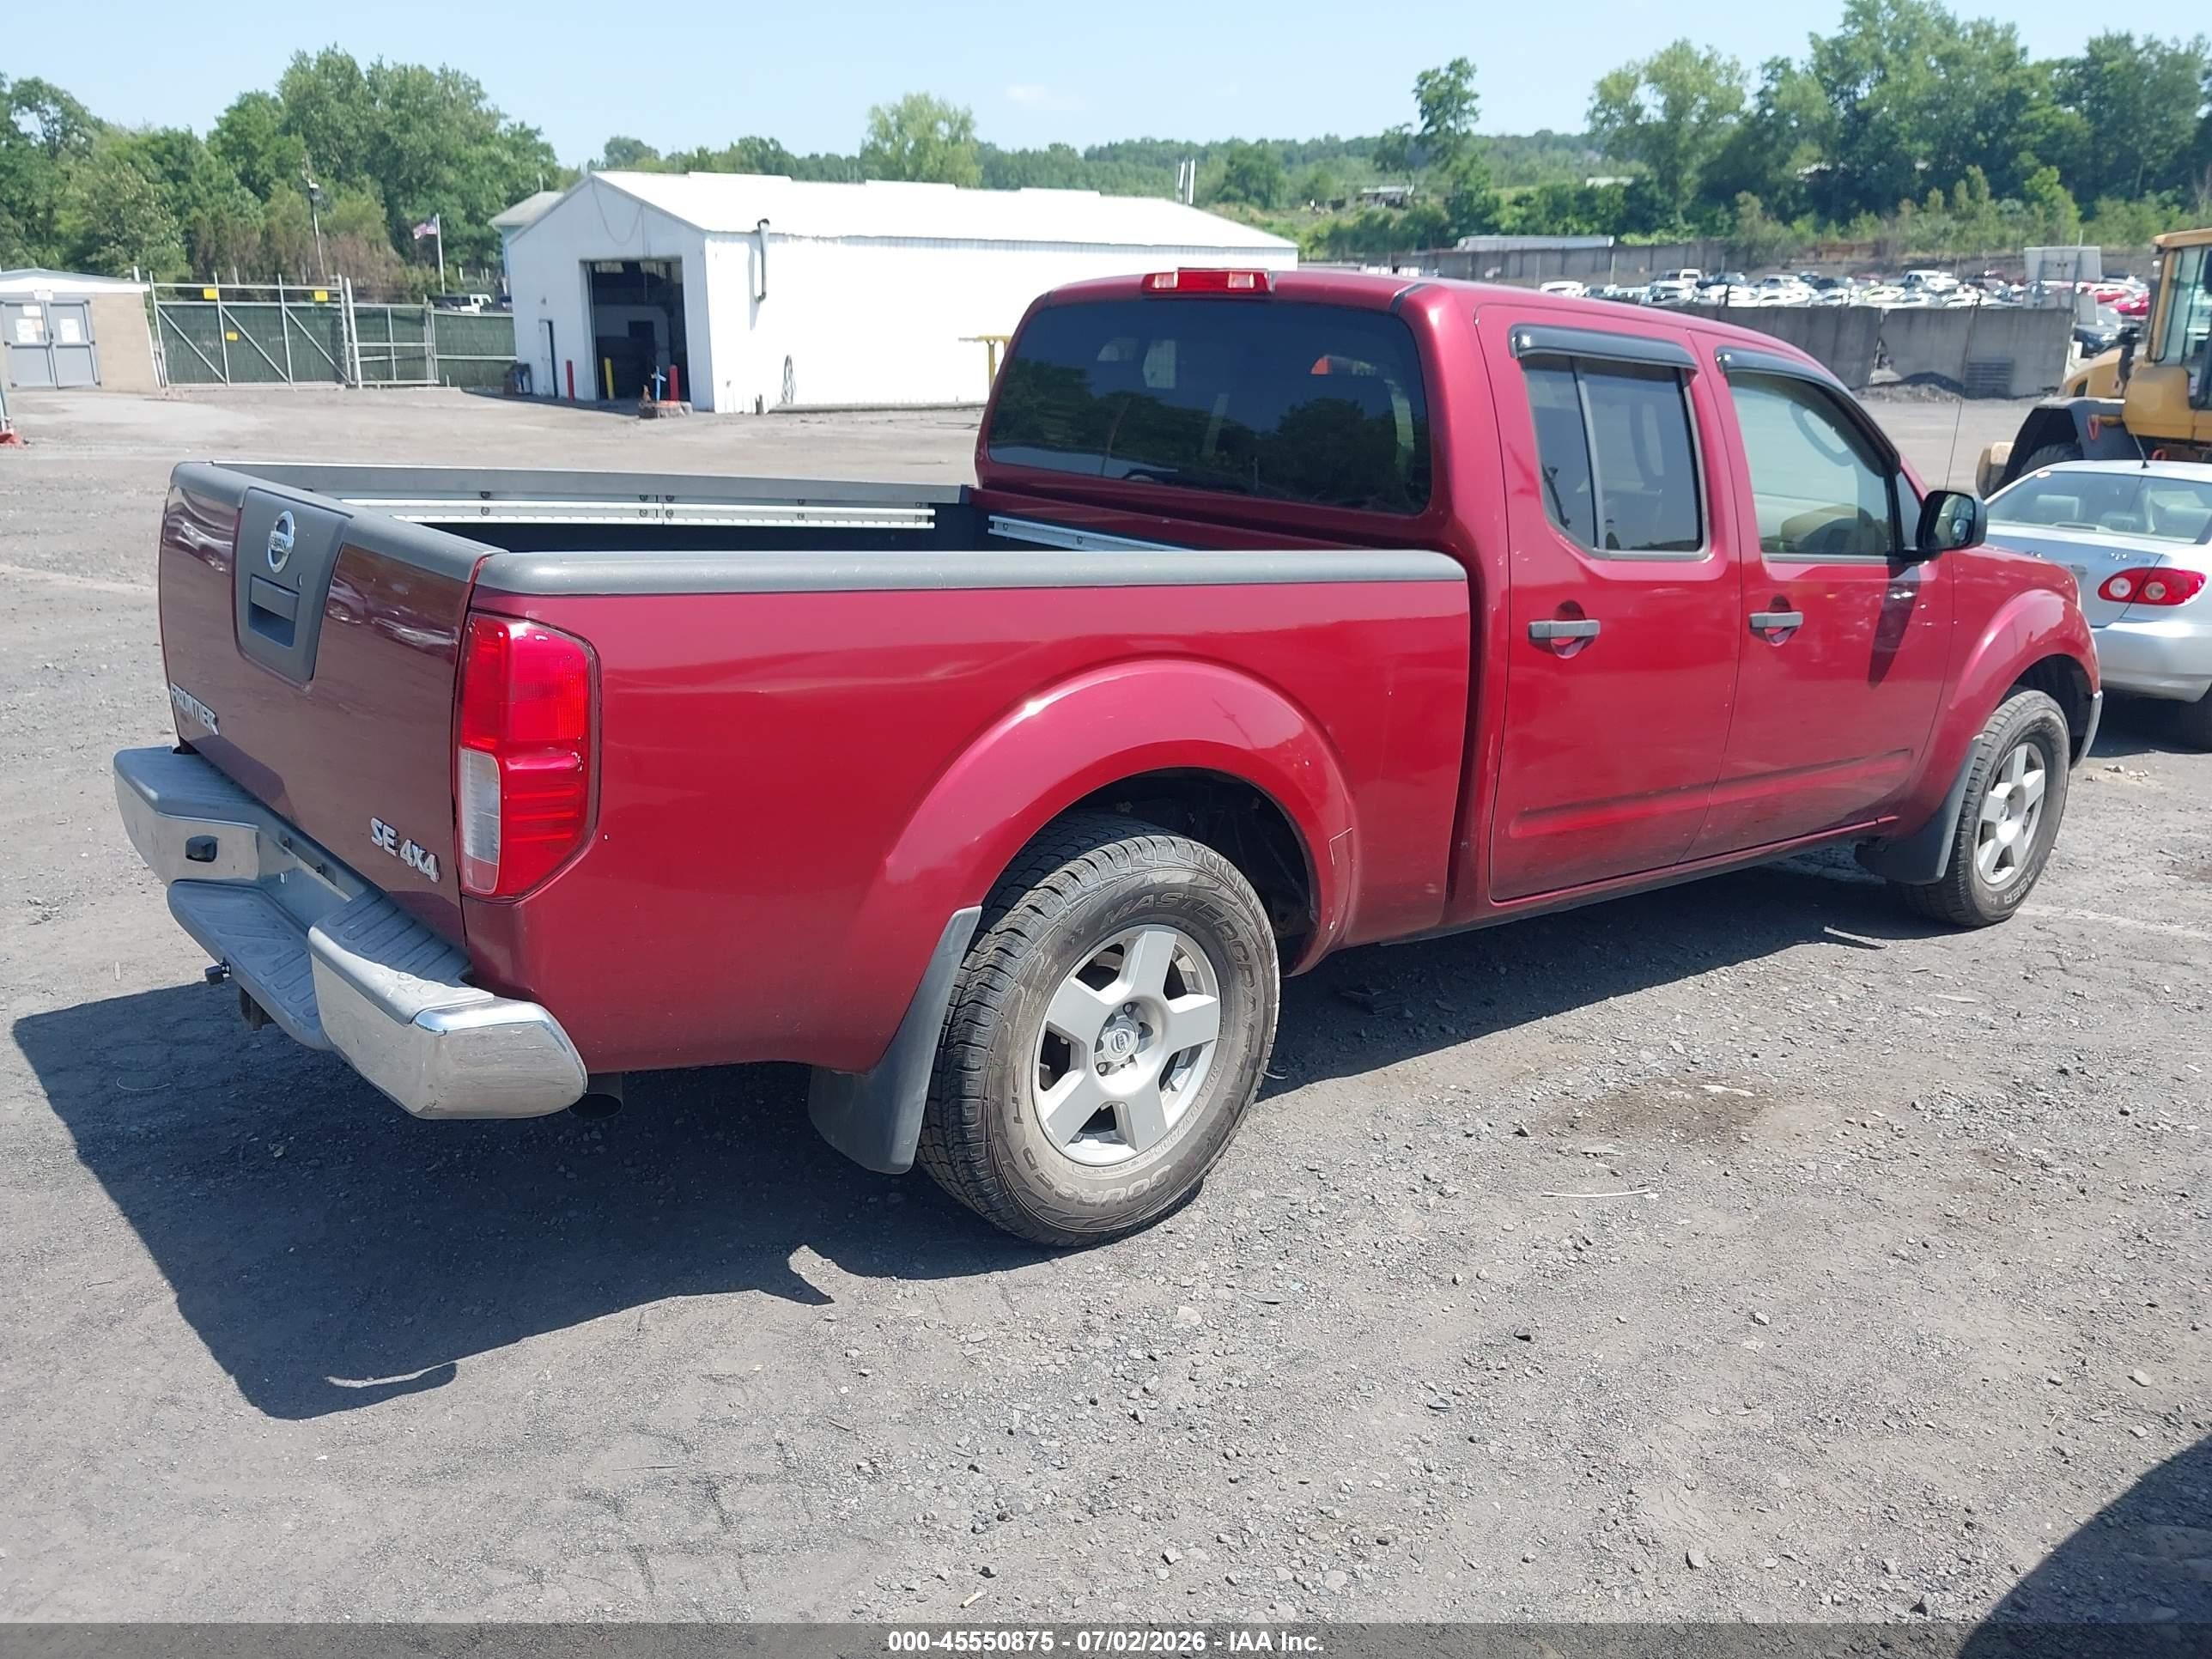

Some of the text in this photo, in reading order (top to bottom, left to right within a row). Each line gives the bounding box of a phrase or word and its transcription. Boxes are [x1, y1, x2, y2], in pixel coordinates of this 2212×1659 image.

[171, 682, 219, 736] FRONTIER
[371, 817, 440, 883] SE 4X4
[1100, 892, 1256, 1083] MASTERCRAFT
